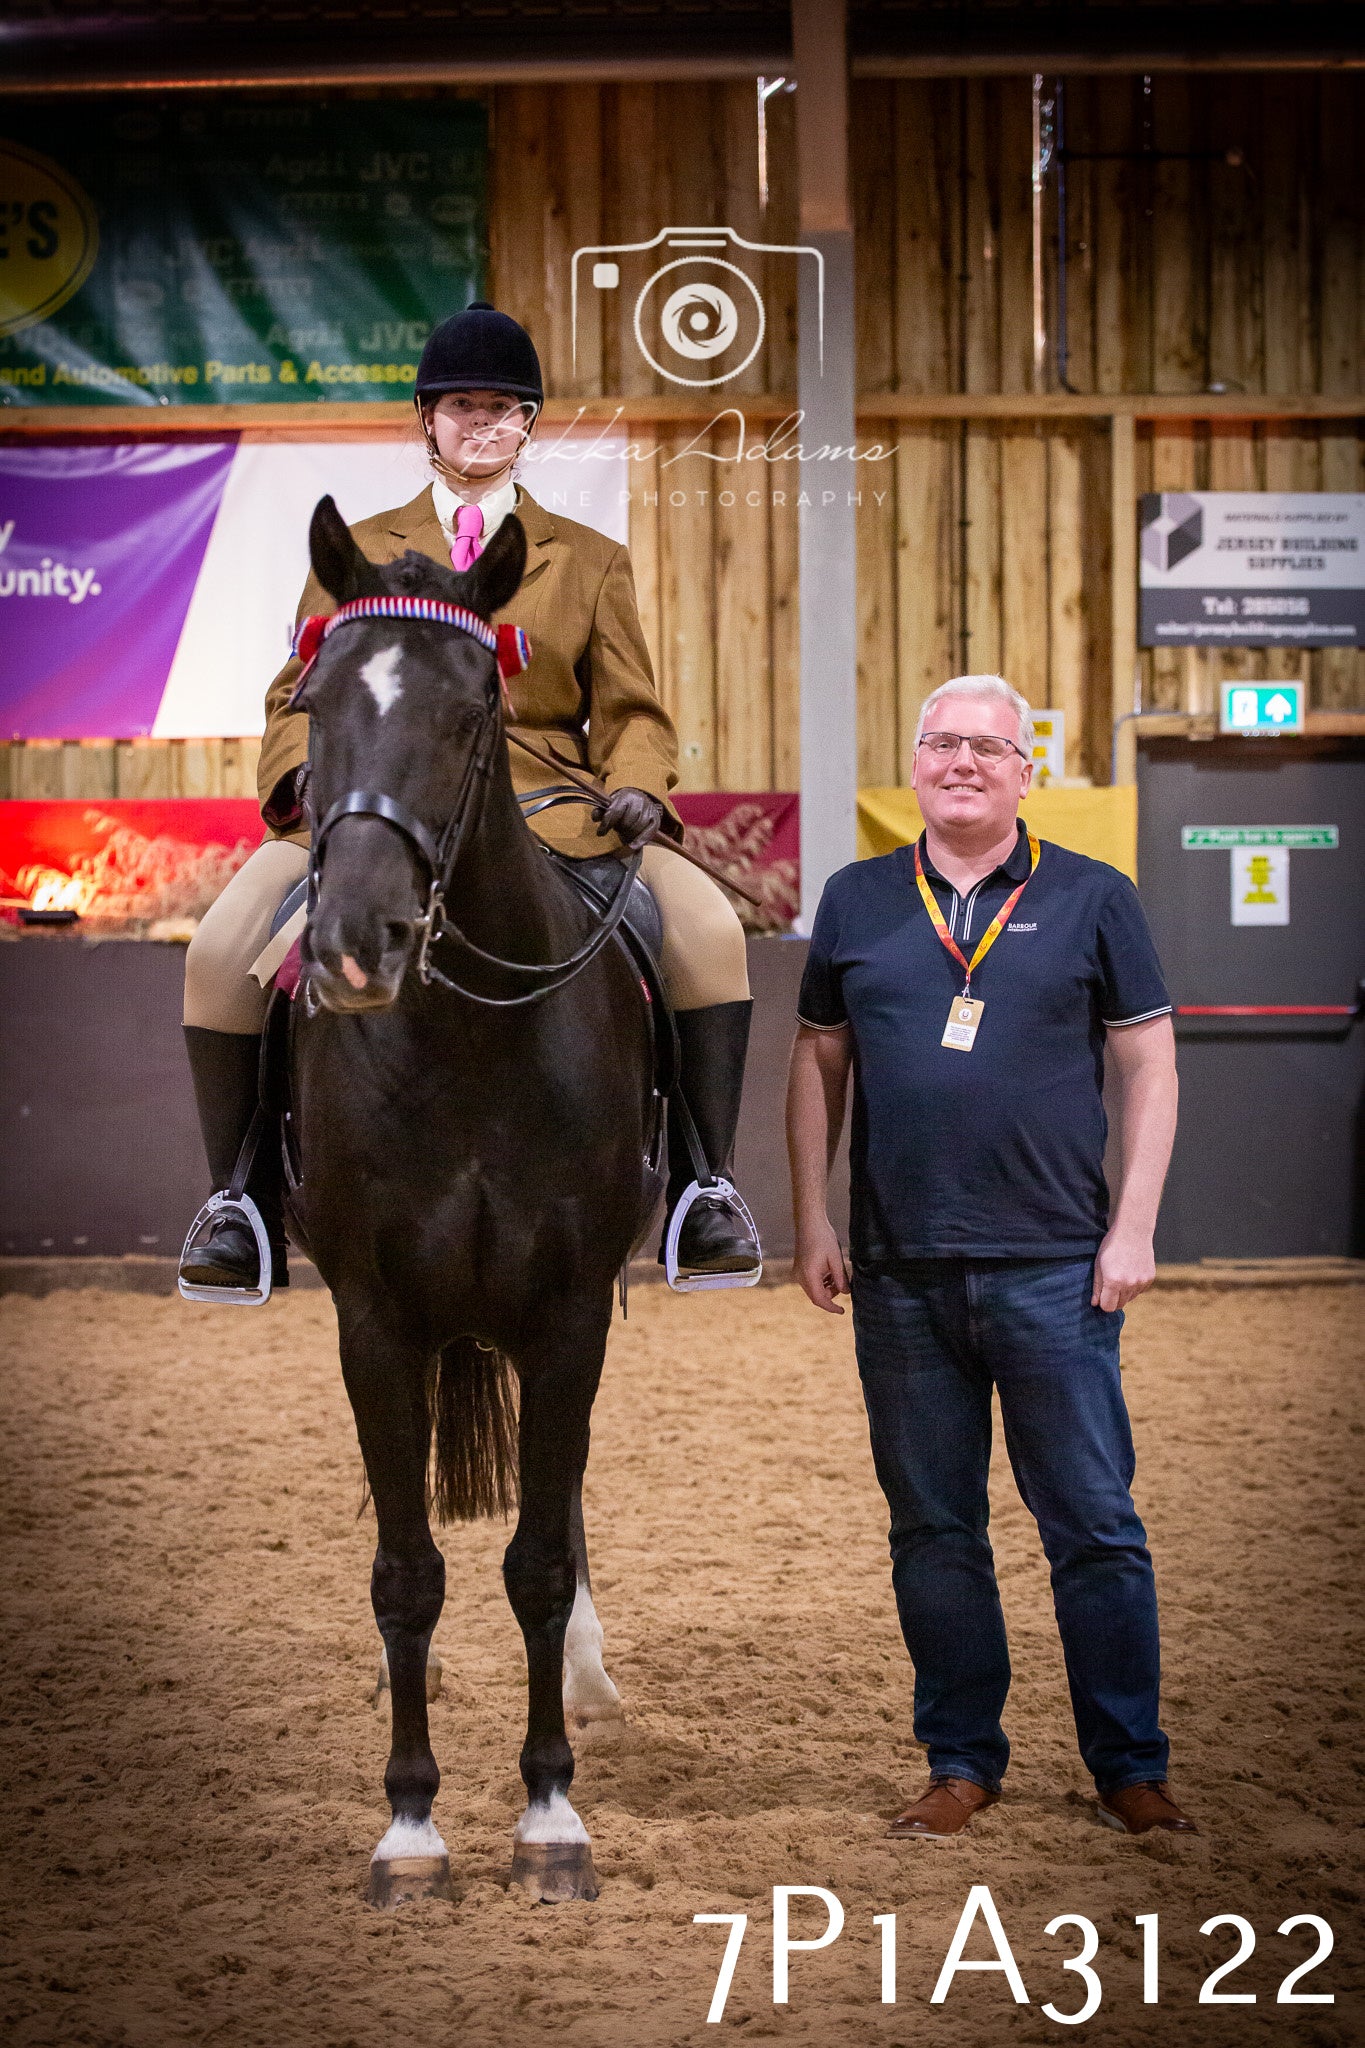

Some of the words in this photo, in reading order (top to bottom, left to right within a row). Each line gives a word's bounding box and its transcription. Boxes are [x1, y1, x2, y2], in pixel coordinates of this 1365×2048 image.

[360, 321, 430, 350] JVC
[53, 362, 199, 386] Automotive
[205, 360, 271, 384] Parts
[279, 361, 298, 384] &
[1217, 536, 1275, 552] JERSEY
[1281, 536, 1359, 552] BUILDING
[1248, 556, 1326, 571] SUPPLIES
[0, 557, 103, 604] unity.
